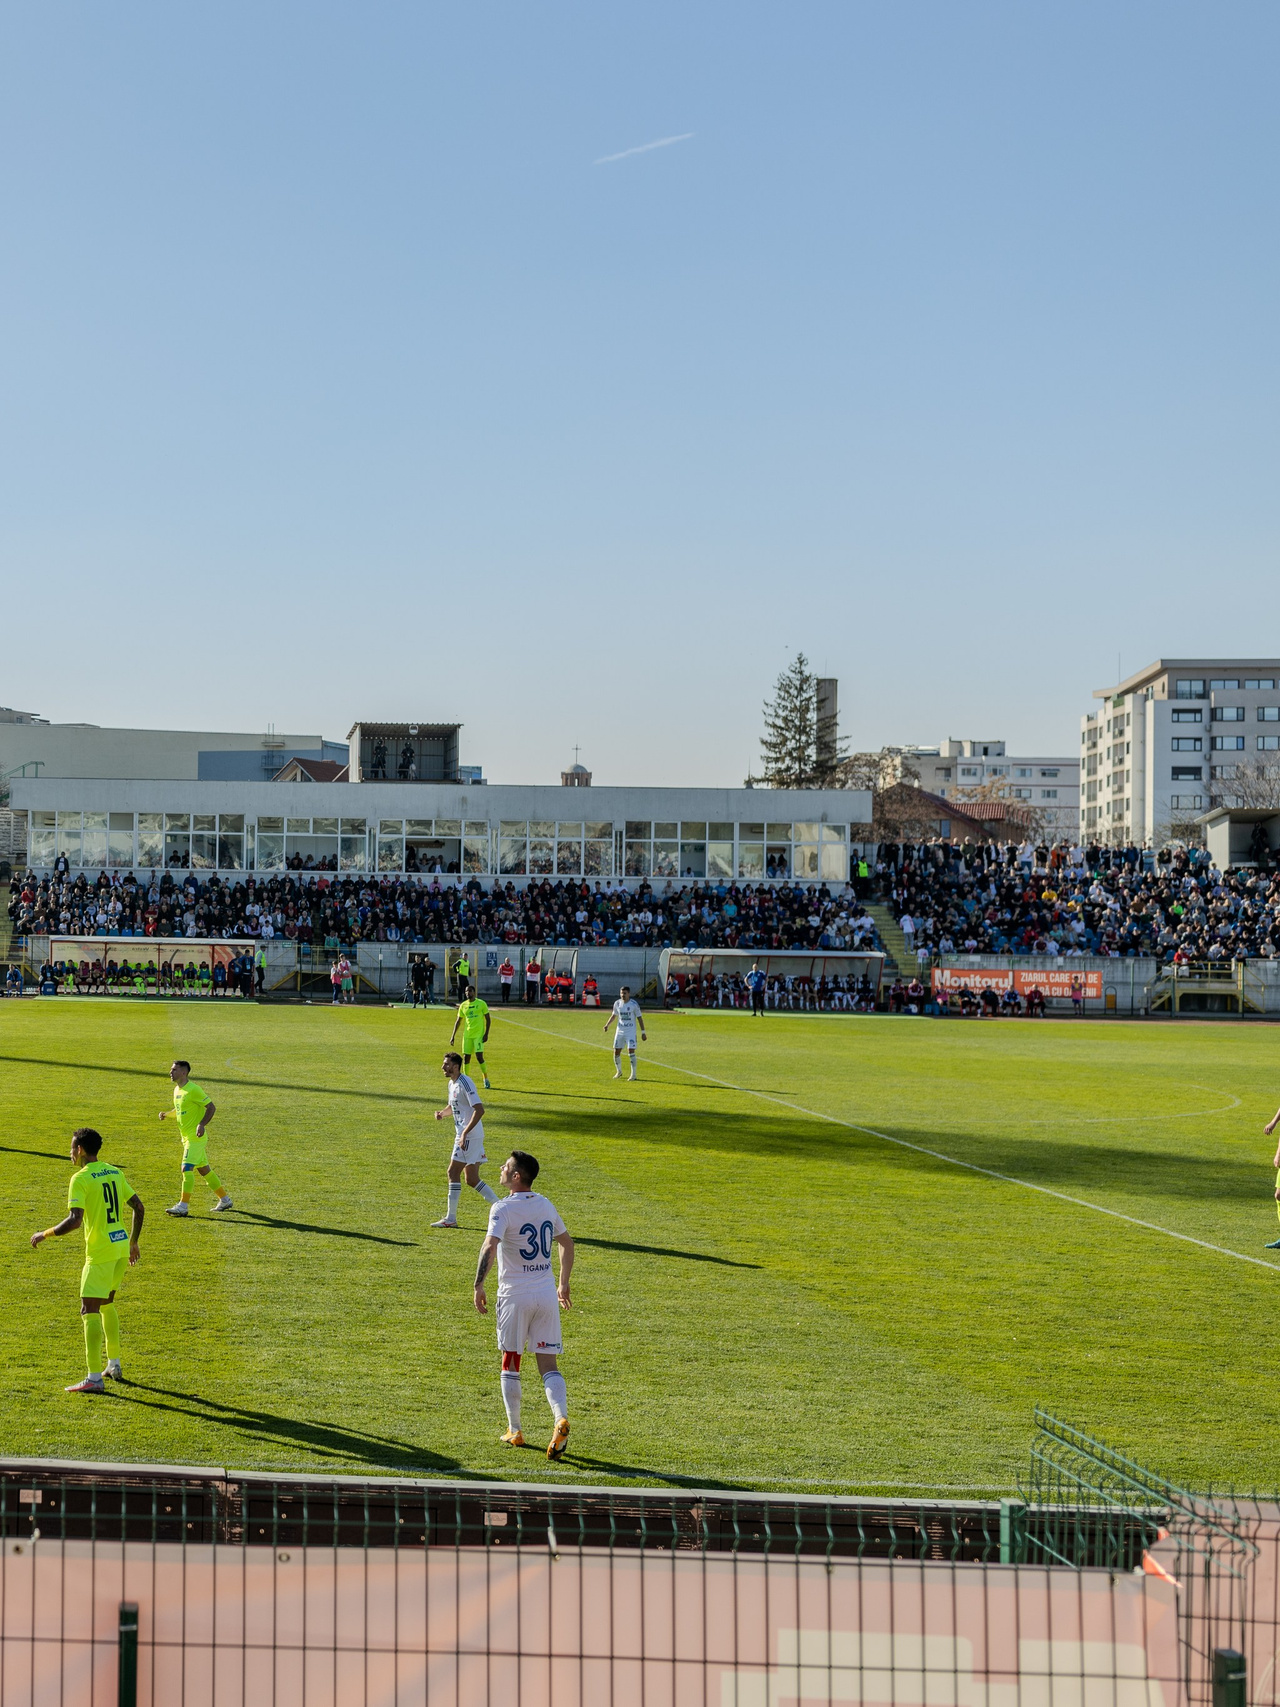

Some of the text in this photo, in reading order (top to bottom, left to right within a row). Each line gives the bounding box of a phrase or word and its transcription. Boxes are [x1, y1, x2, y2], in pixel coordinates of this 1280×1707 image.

[934, 969, 1013, 988] Monitorul
[1020, 972, 1048, 983] ZIARUL
[1049, 973, 1070, 983] CARE
[1088, 973, 1098, 984] DE
[1051, 986, 1062, 997] CU
[102, 1181, 120, 1224] 21
[519, 1220, 554, 1260] 30
